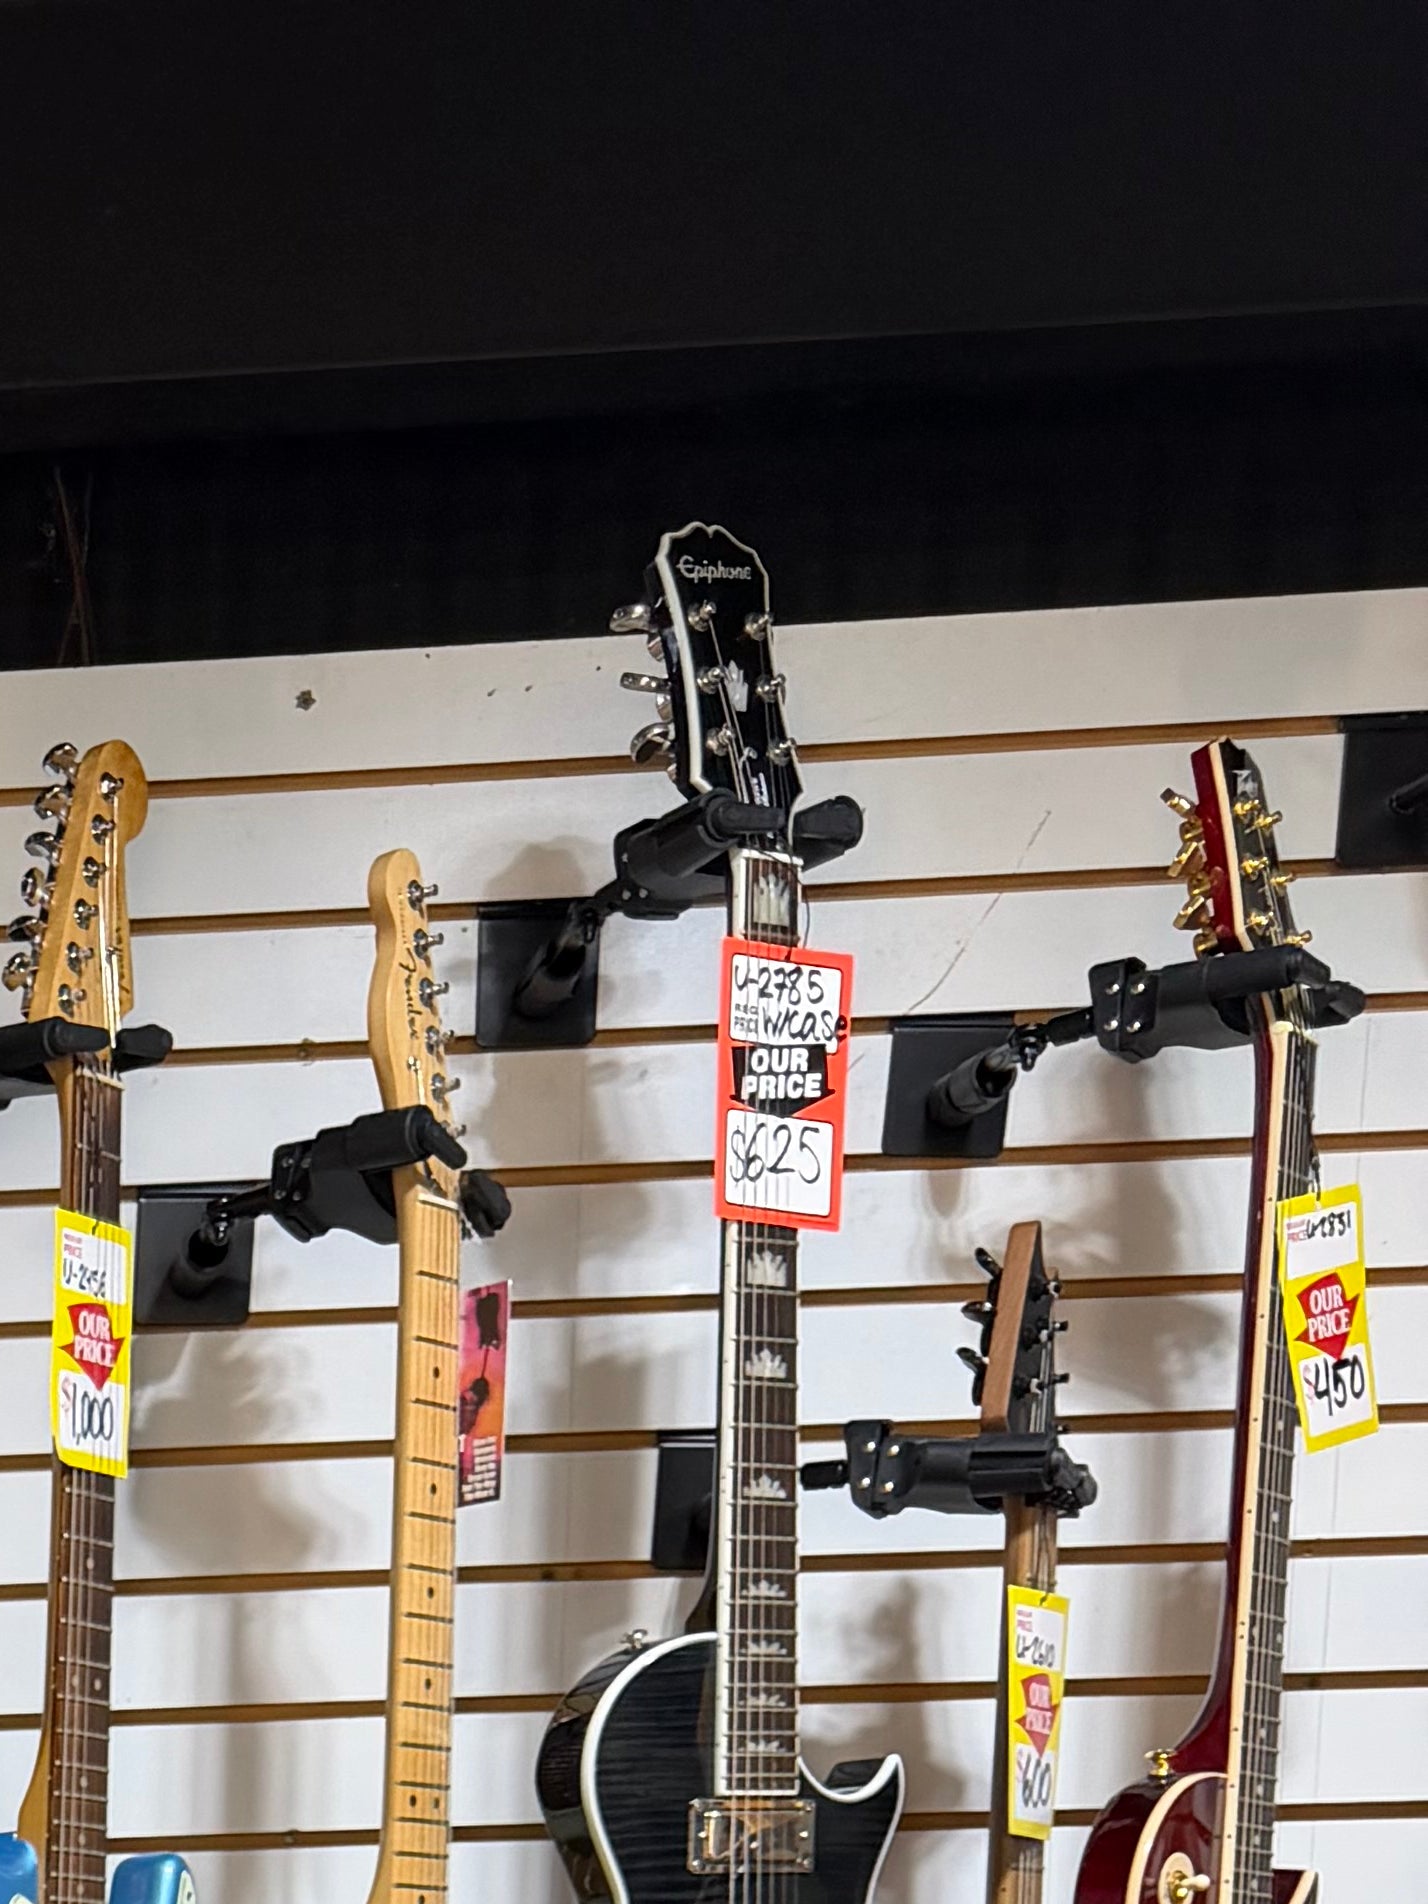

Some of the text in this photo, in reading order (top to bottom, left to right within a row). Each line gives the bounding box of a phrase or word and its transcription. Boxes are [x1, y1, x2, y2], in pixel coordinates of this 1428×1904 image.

[676, 554, 753, 585] Epiphone
[398, 947, 424, 1041] Fender
[750, 1047, 810, 1074] OUR
[740, 1072, 823, 1101] PRICE
[729, 1123, 822, 1188] $625
[1309, 1284, 1344, 1315] OUR
[77, 1309, 111, 1342] OUR
[1307, 1308, 1351, 1343] PRICE
[73, 1333, 117, 1369] PRICE
[1302, 1355, 1366, 1418] $450
[61, 1375, 115, 1446] $1,000
[1028, 1681, 1051, 1707] OUR
